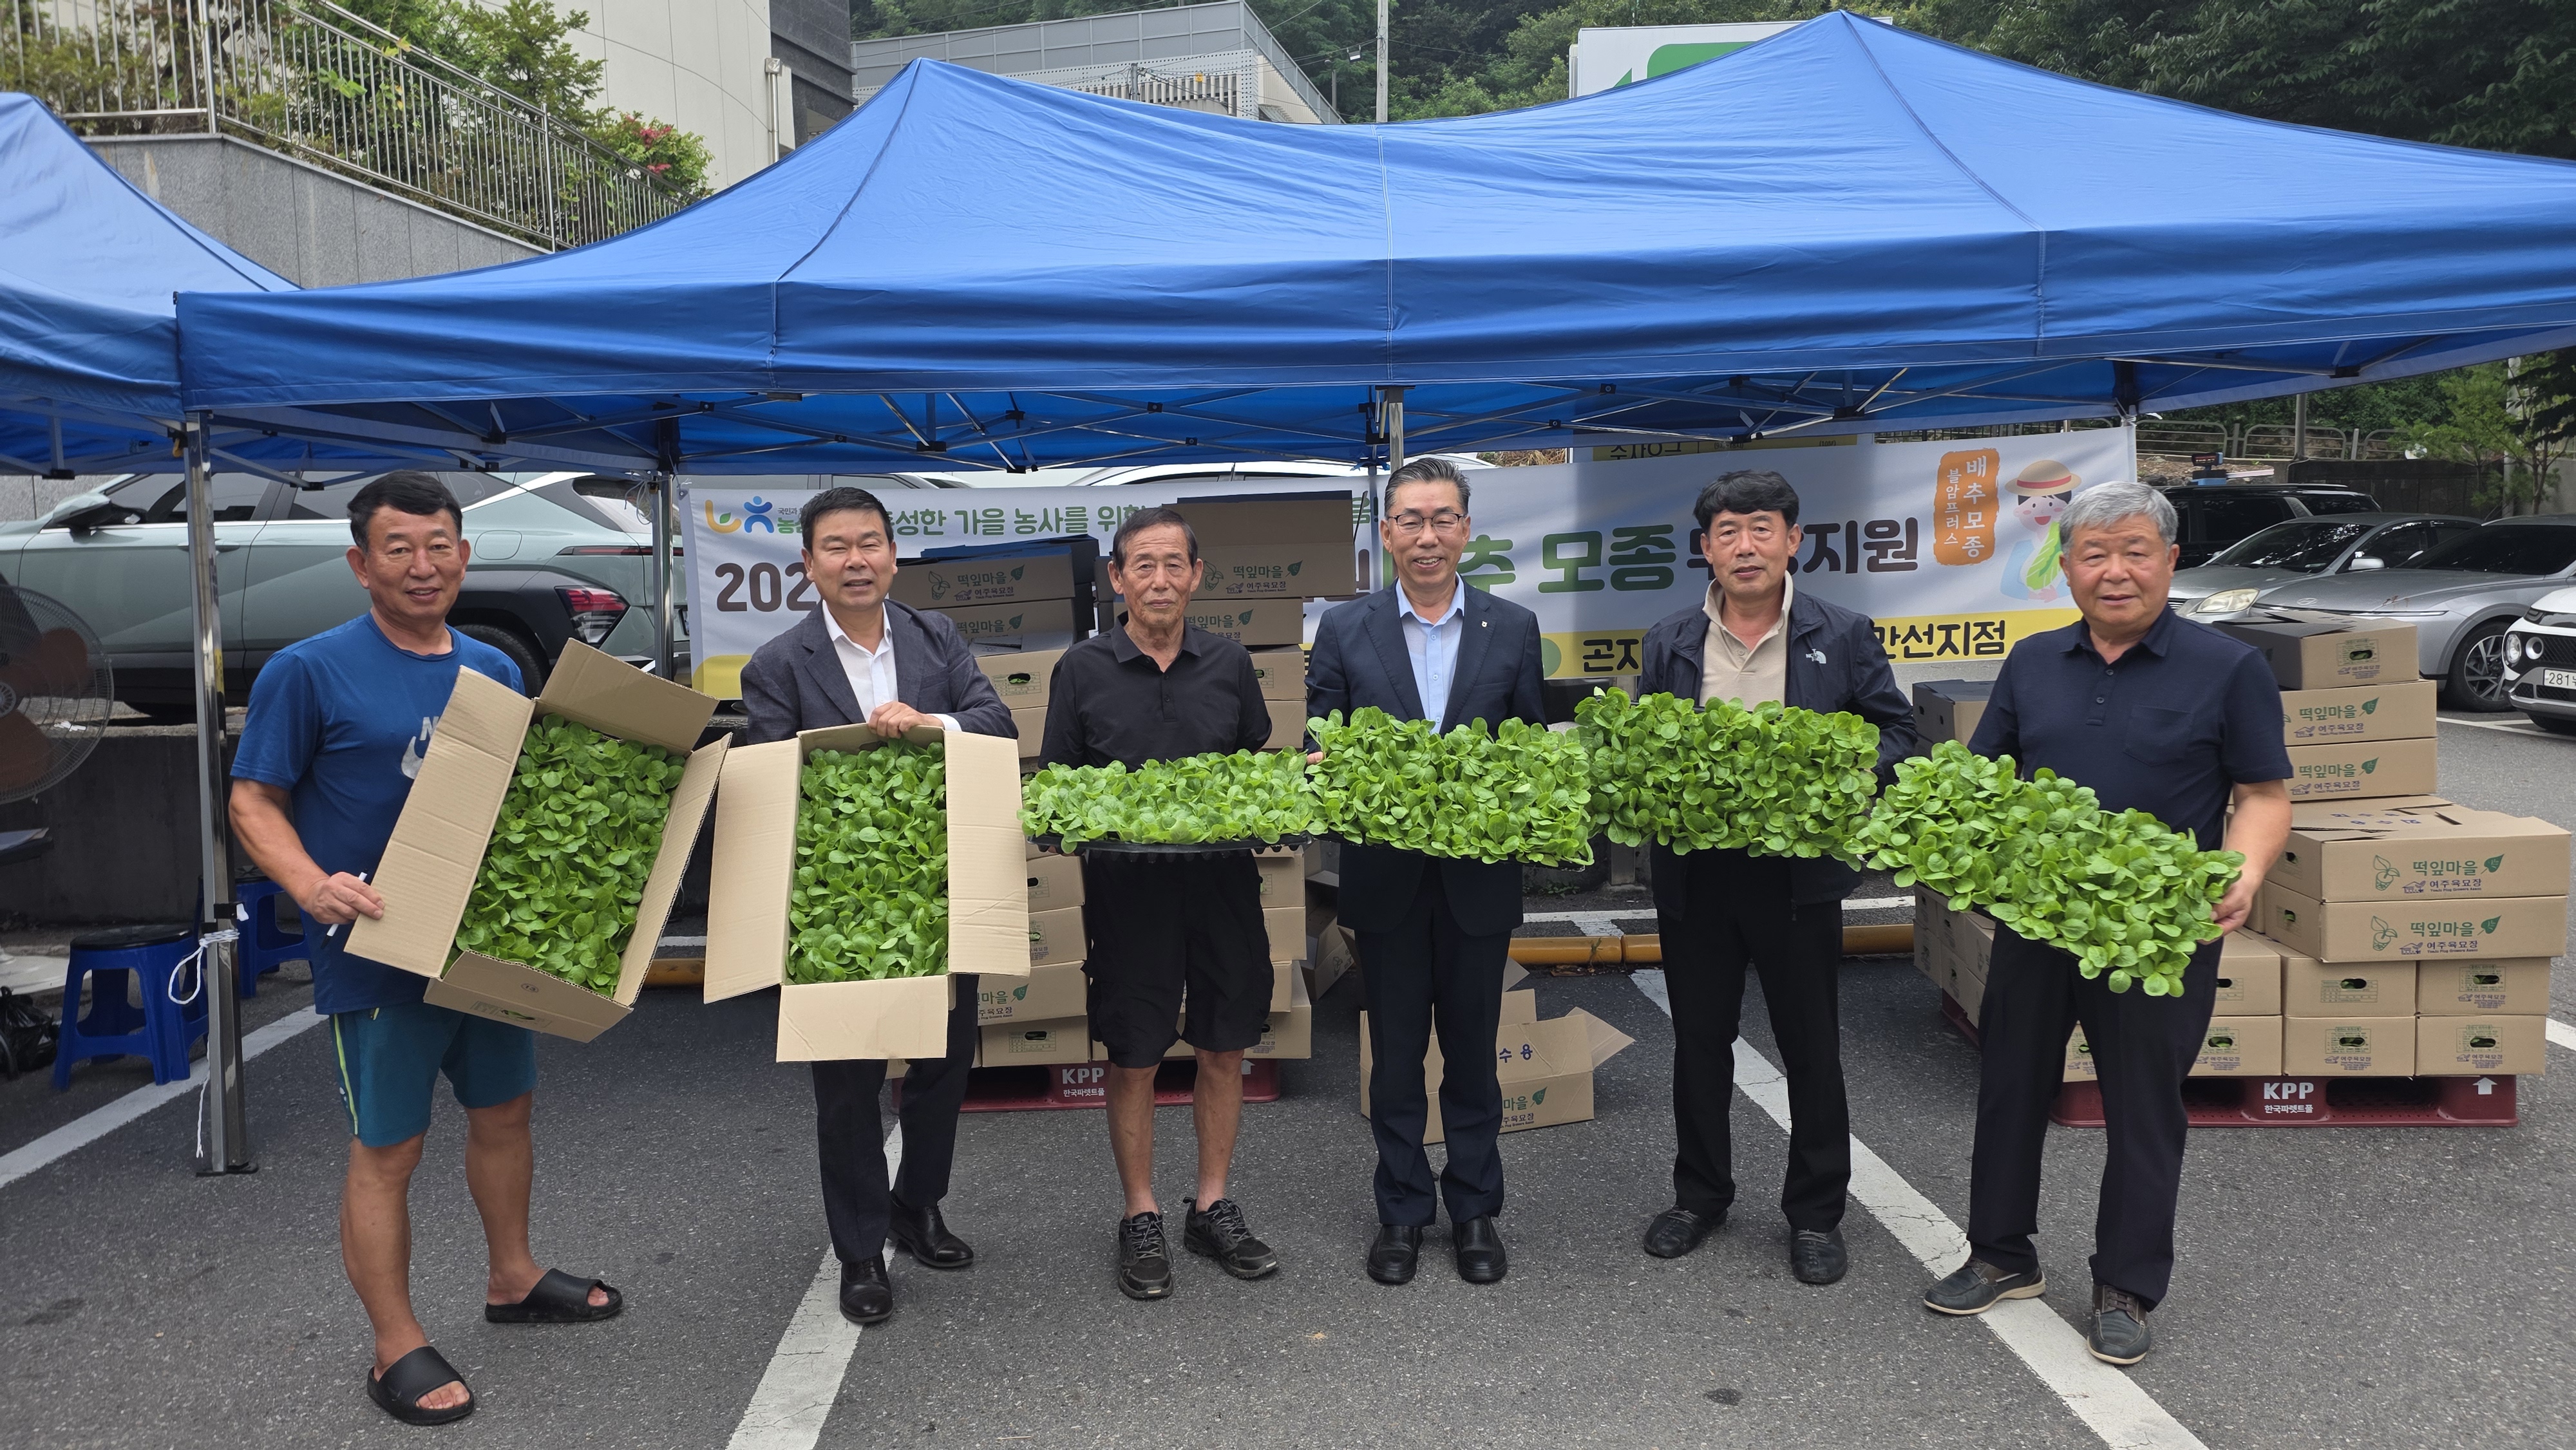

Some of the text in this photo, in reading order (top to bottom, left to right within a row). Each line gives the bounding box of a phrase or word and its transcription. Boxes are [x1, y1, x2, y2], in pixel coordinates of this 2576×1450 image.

[1962, 455, 1987, 558] 배추모종
[886, 508, 947, 536] 성한
[954, 508, 1005, 536] 가을
[1014, 505, 1090, 535] 농사를
[715, 561, 818, 612] 202
[1538, 524, 1676, 594] 모종
[1582, 638, 1640, 672] 곤지
[2299, 704, 2357, 721] 떡잎마을
[2299, 764, 2356, 778] 떡잎마을
[2413, 860, 2477, 876] 떡잎마을
[2430, 878, 2481, 888] 여주육묘장
[2410, 922, 2474, 937] 떡잎마을
[2427, 940, 2478, 950] 여주육묘장
[977, 990, 1008, 1005] 마을
[978, 1006, 1012, 1016] 주육묘장
[1062, 1068, 1104, 1084] KPP
[1063, 1088, 1104, 1097] 한국파렛트풀
[2264, 1082, 2314, 1100] KPP
[1503, 1096, 1528, 1111] 마을
[2264, 1104, 2313, 1114] 한국파렛트풀
[1503, 1113, 1534, 1124] 주육묘장
